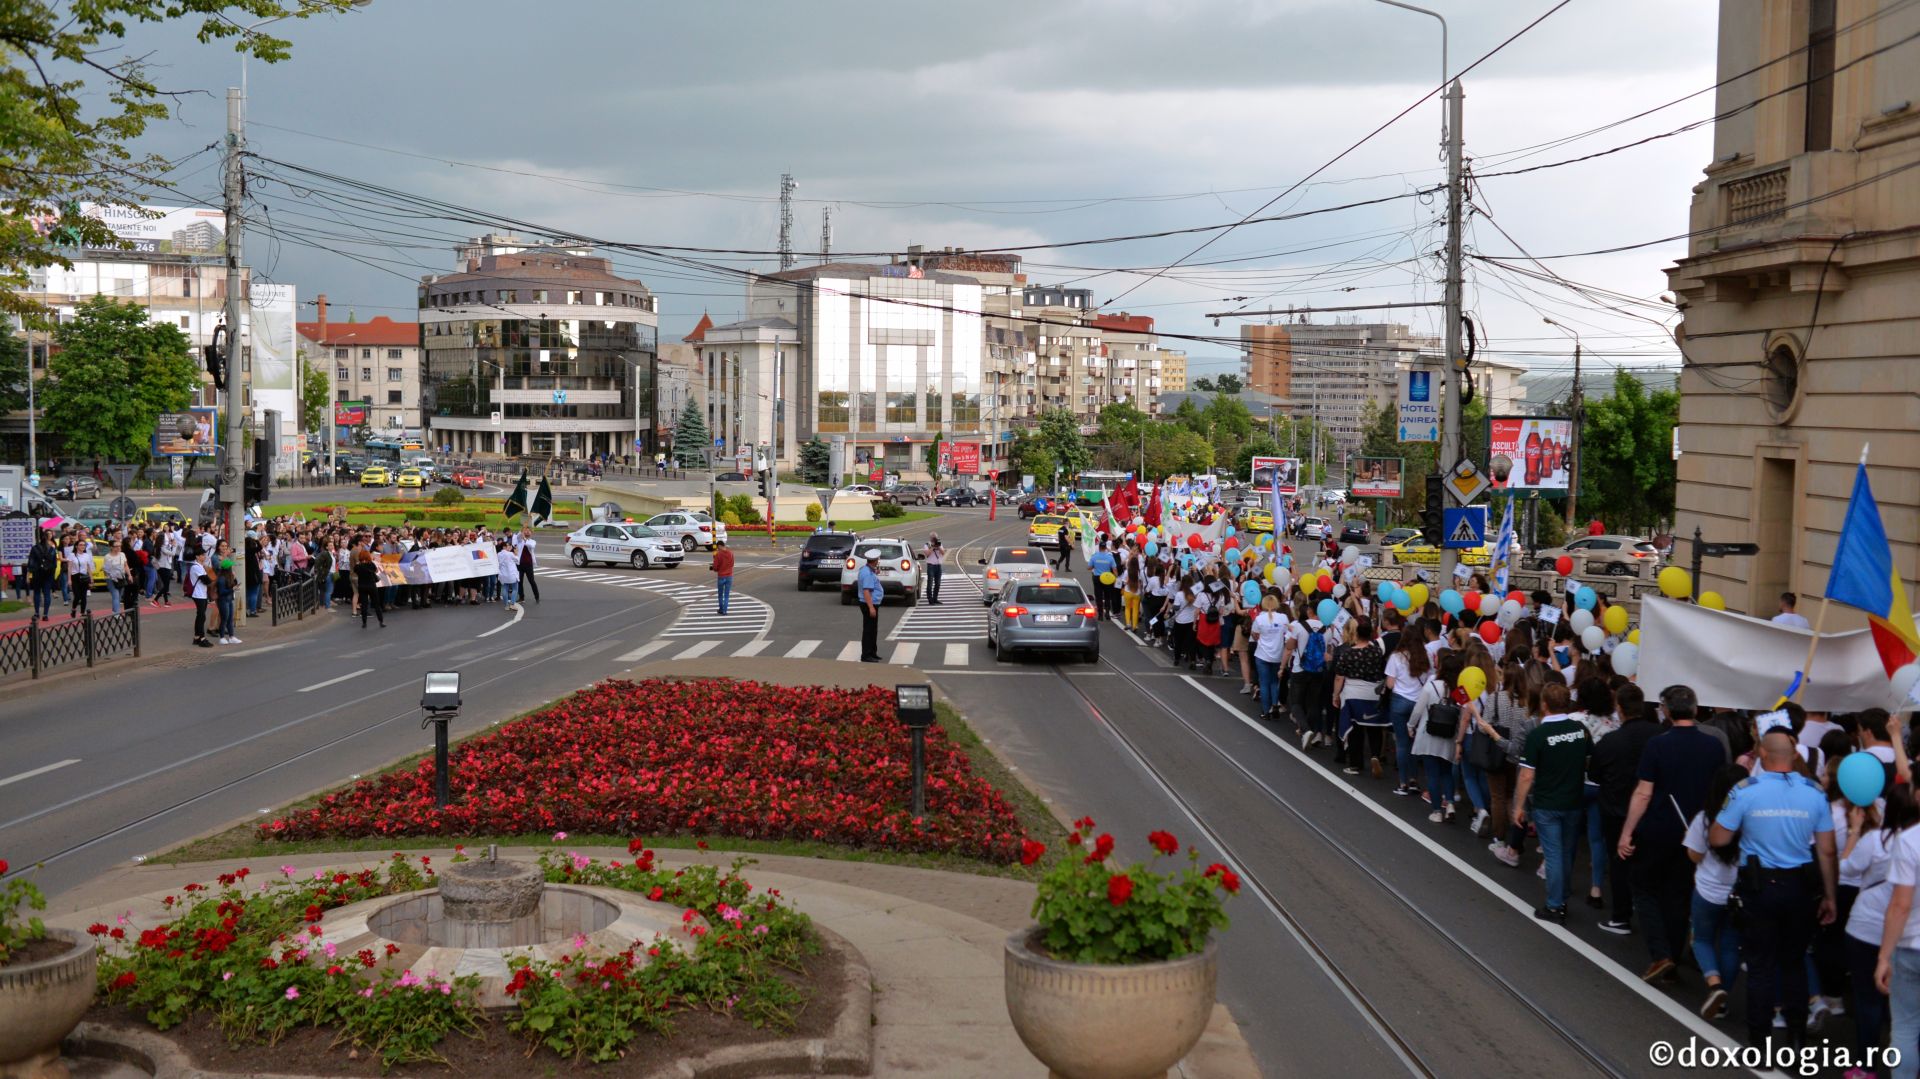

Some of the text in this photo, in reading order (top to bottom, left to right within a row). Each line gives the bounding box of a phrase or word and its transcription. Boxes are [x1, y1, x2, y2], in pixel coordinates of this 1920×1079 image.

[135, 243, 155, 252] 245
[1400, 404, 1437, 413] HOTEL
[1399, 416, 1438, 424] UNIREA
